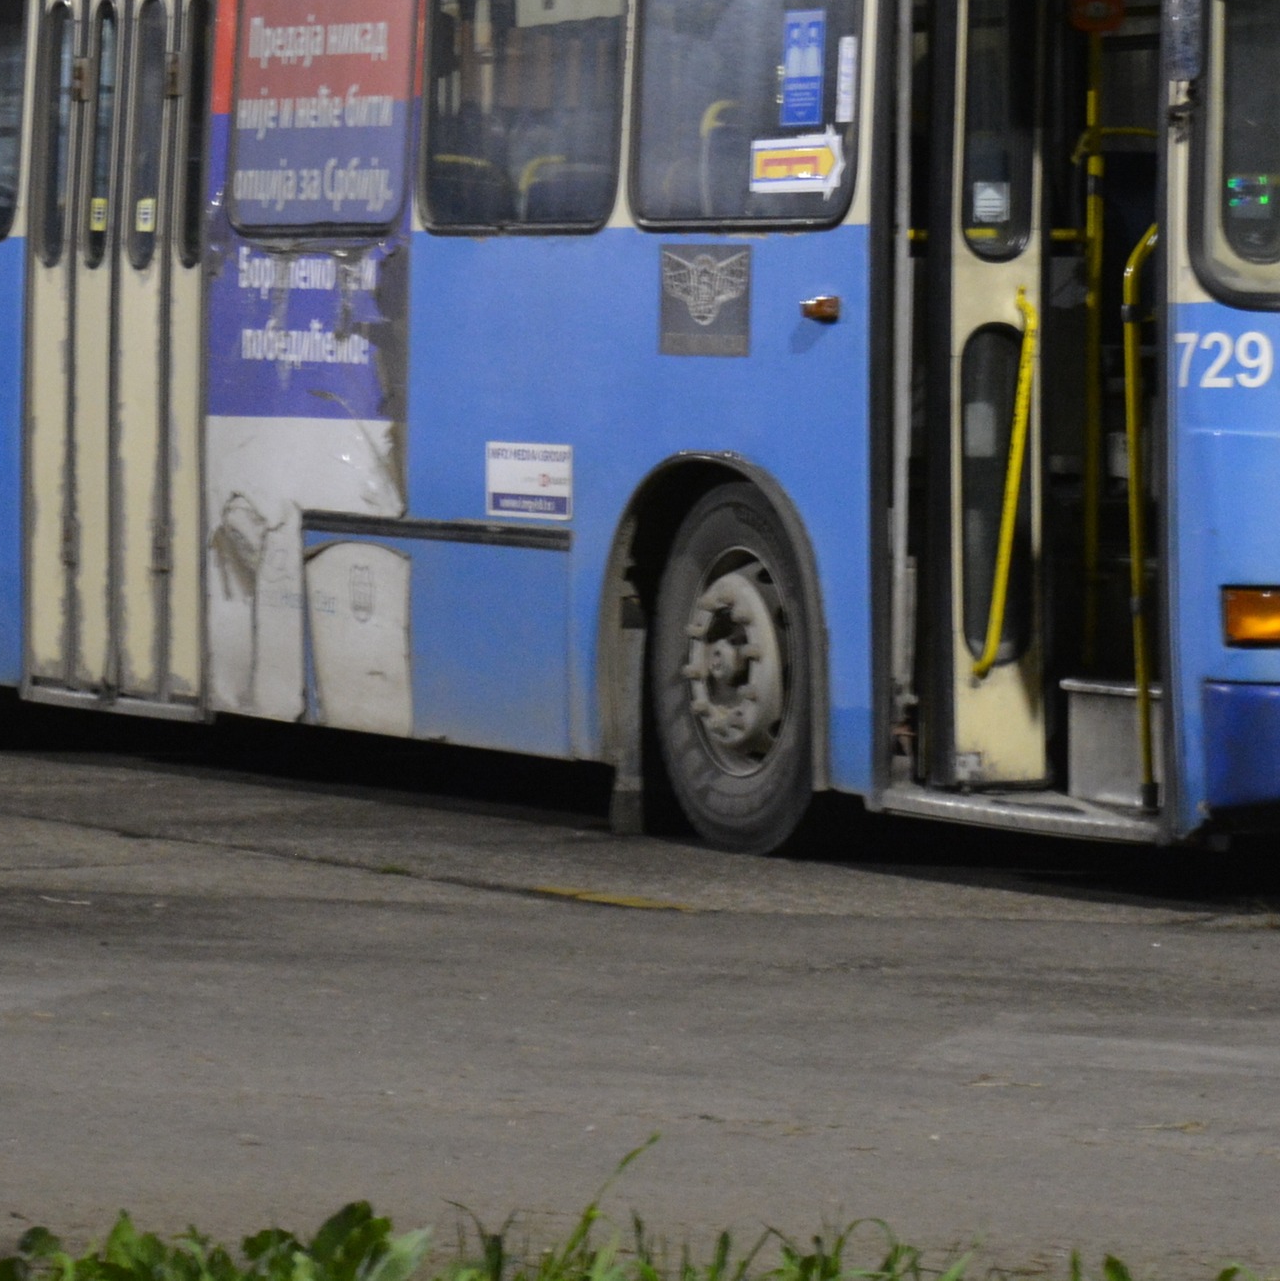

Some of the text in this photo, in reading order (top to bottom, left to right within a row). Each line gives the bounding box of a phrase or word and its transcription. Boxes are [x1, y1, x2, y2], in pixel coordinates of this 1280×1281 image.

[249, 14, 388, 68] Предаја никад
[236, 84, 394, 140] није и неће бити
[233, 158, 297, 211] опција
[298, 169, 320, 200] за
[1174, 331, 1274, 388] 729
